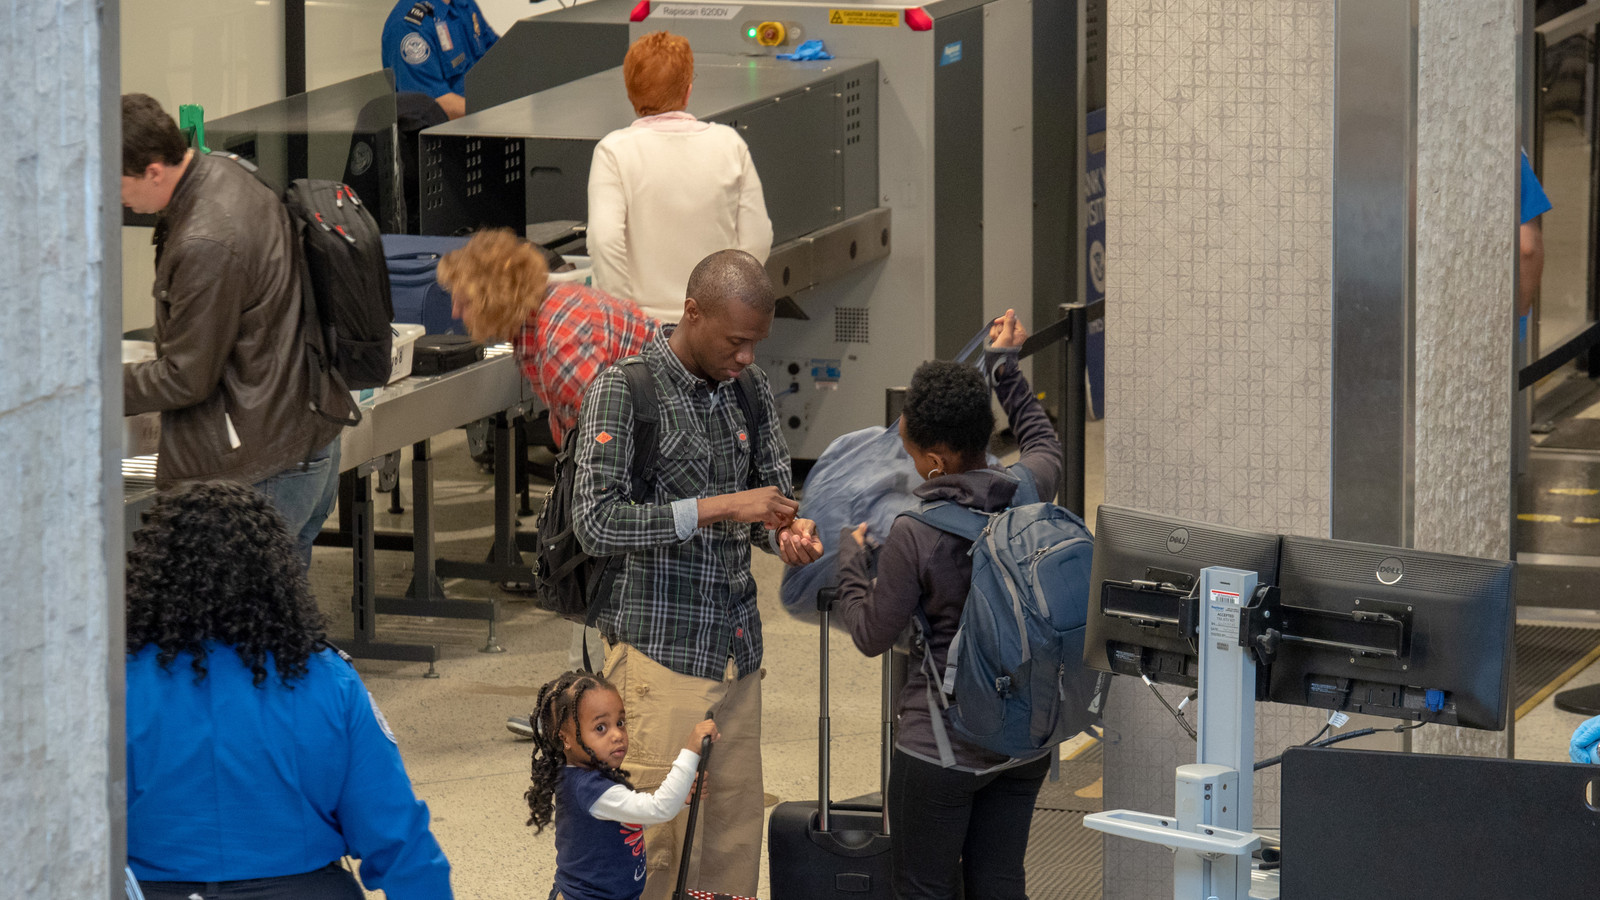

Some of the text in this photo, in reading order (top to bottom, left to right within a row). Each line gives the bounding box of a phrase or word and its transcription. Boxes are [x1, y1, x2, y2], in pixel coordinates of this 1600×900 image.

[663, 7, 699, 16] Rapiscan
[1169, 535, 1186, 545] DELL
[1380, 566, 1401, 574] DELL
